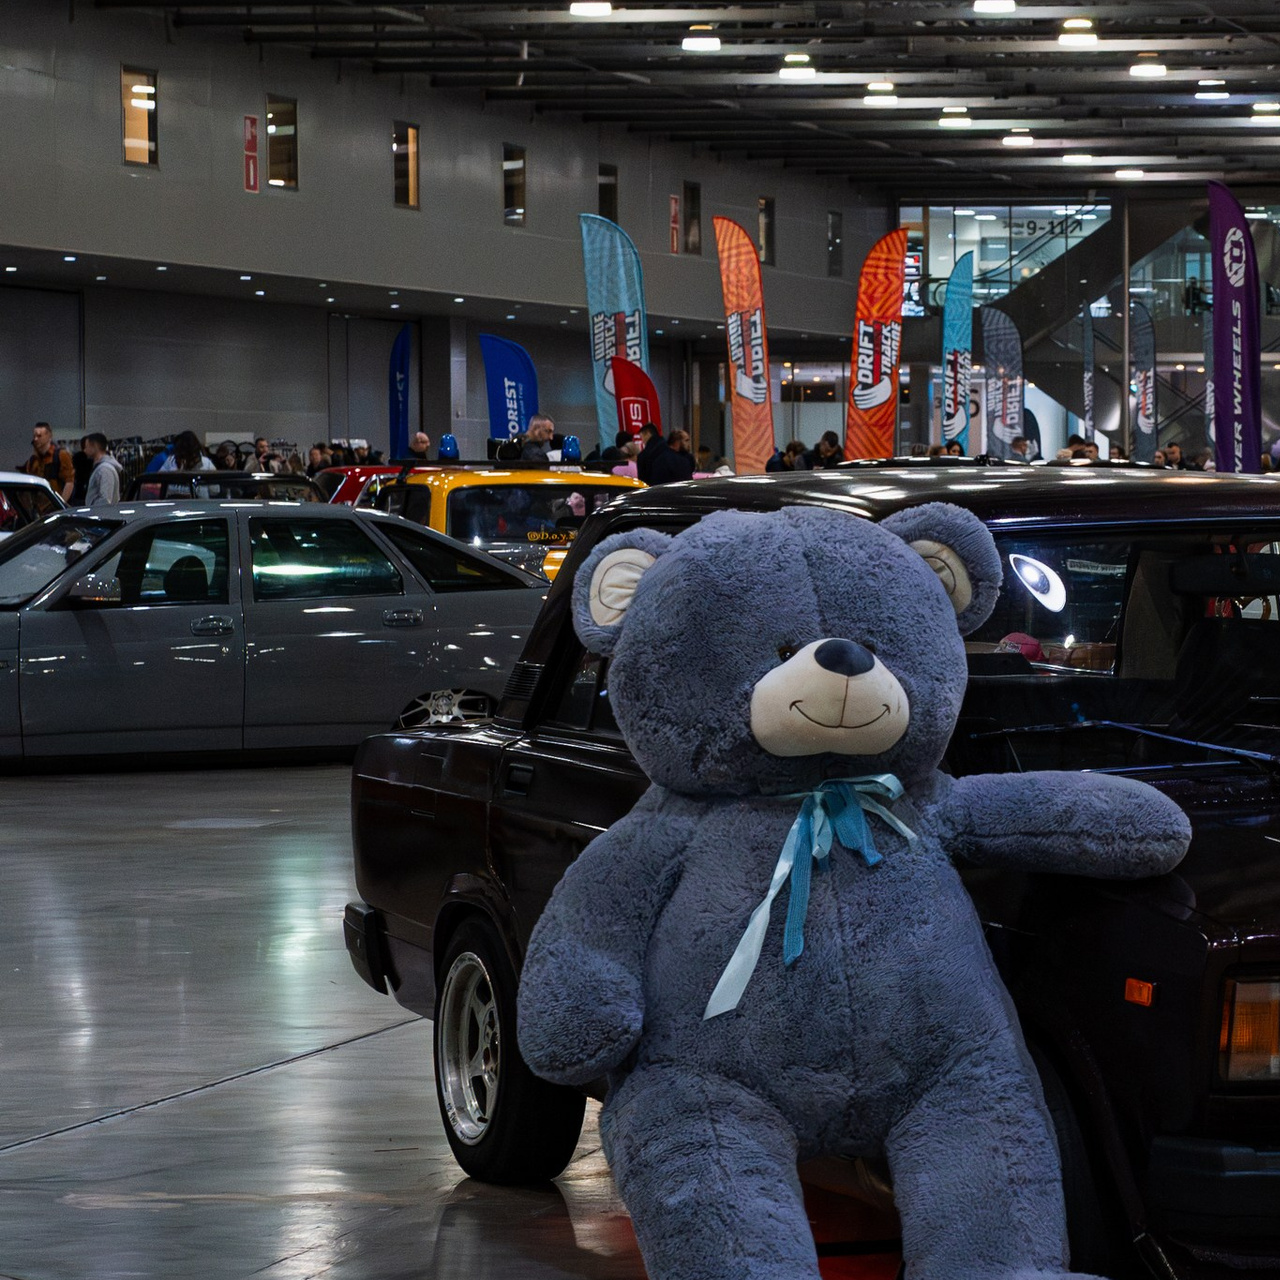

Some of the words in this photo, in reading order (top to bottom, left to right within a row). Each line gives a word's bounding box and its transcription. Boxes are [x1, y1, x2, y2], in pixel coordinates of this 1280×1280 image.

[857, 320, 874, 384] DRIFT
[880, 324, 892, 374] TRACK
[945, 349, 956, 414] DRIFT
[1232, 300, 1242, 415] WHEELS
[504, 376, 520, 441] OREST
